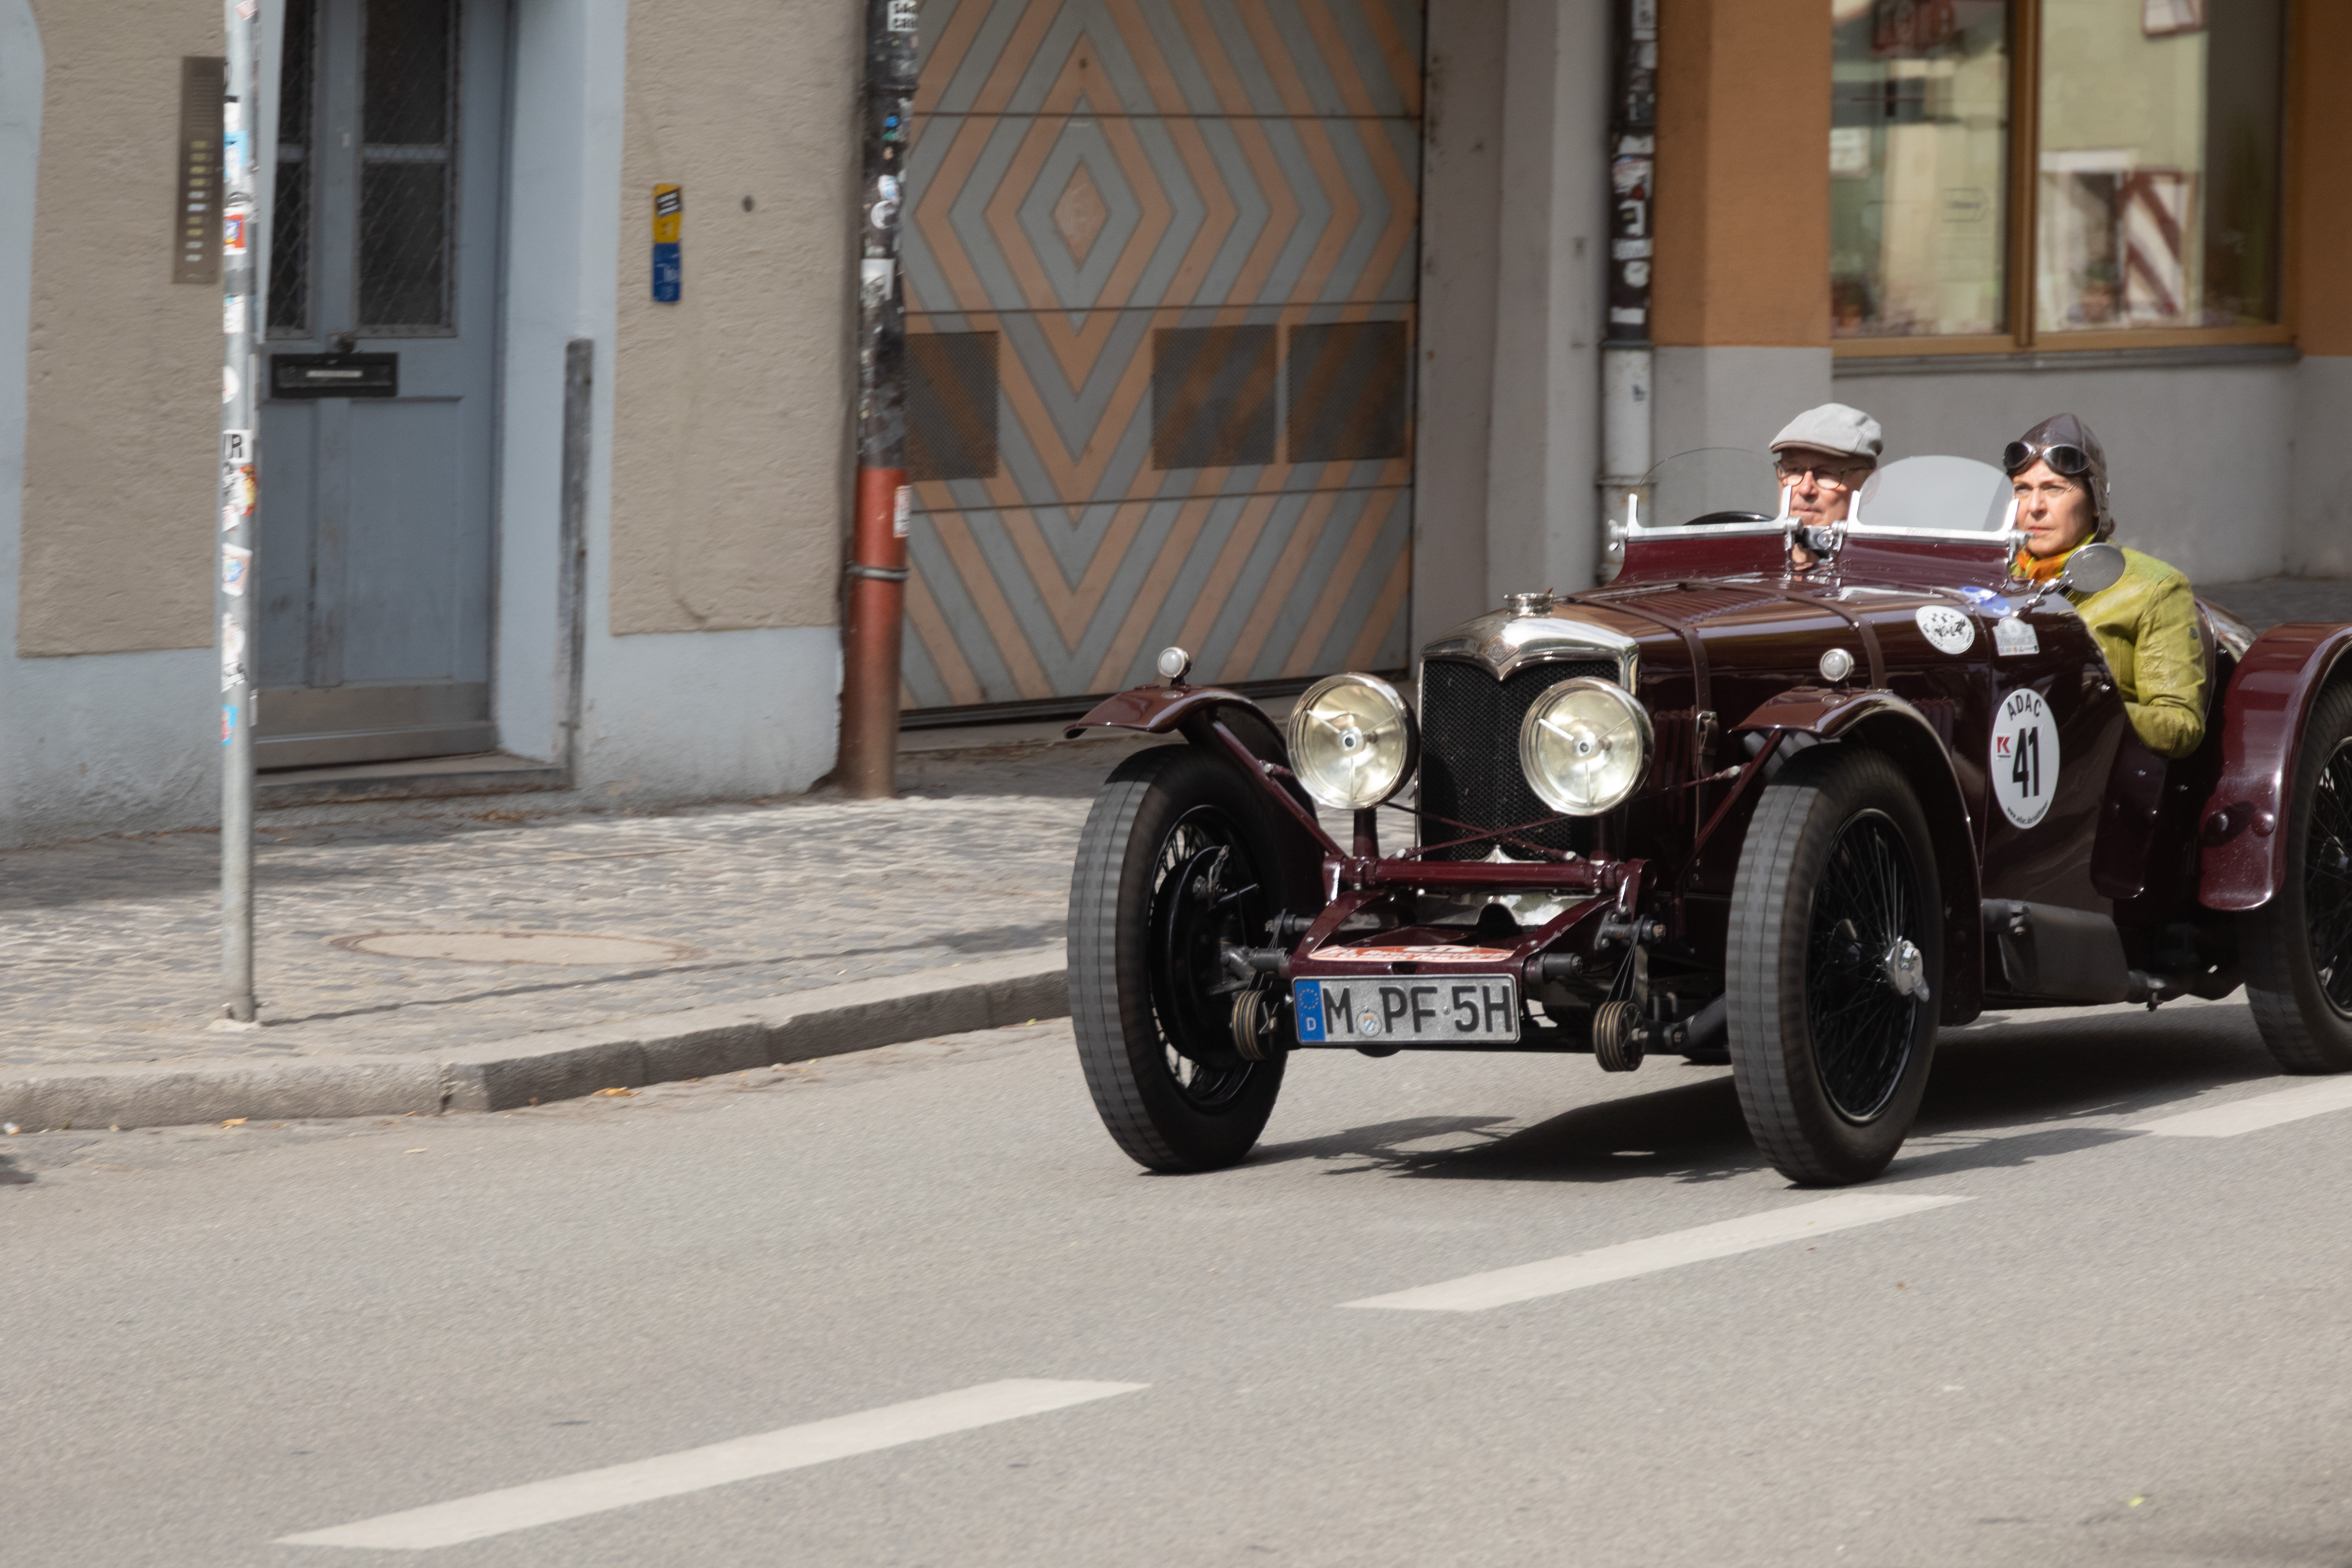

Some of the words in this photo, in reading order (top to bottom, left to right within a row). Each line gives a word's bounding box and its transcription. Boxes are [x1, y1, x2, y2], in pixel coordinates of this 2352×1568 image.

[2007, 693, 2042, 721] ADAC
[1997, 736, 2011, 753] K
[2012, 726, 2040, 798] 41
[1322, 987, 1354, 1034] M
[1379, 986, 1438, 1033] PF
[1451, 985, 1513, 1033] 5H
[1306, 1017, 1316, 1031] D
